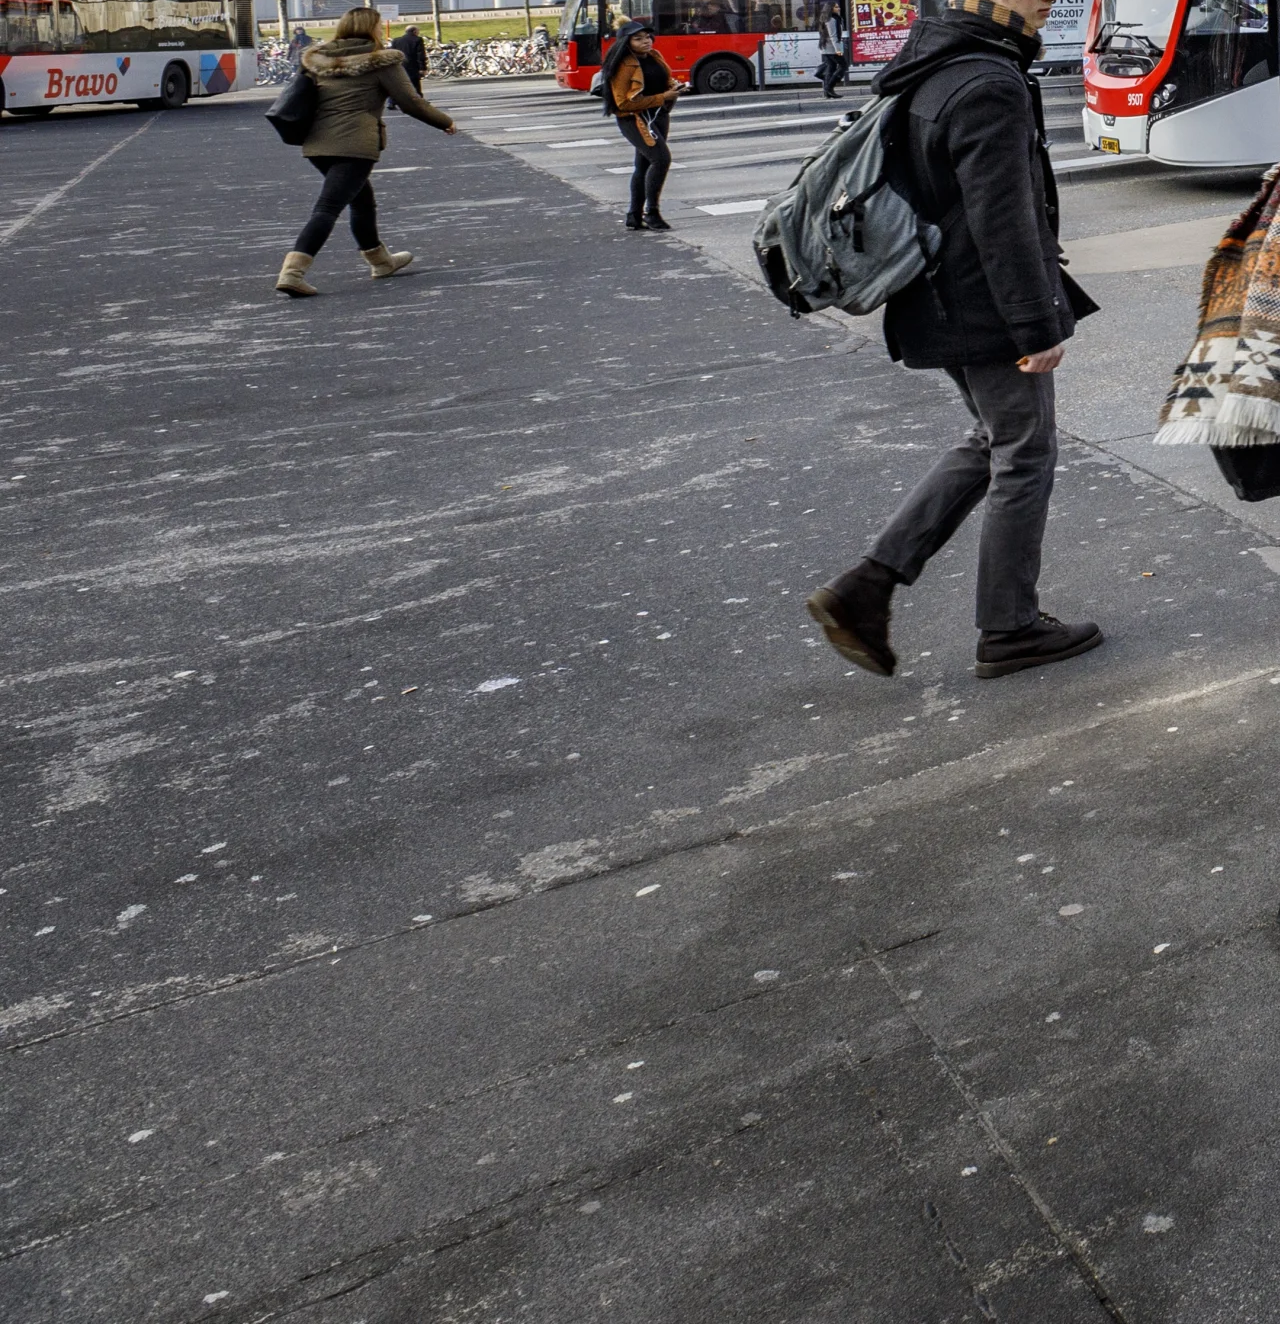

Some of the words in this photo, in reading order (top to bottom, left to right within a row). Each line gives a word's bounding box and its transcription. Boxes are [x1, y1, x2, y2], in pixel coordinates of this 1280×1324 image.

[858, 4, 870, 13] 24
[1050, 9, 1085, 18] 062017
[44, 68, 118, 99] Bravo
[1127, 93, 1144, 106] 9507
